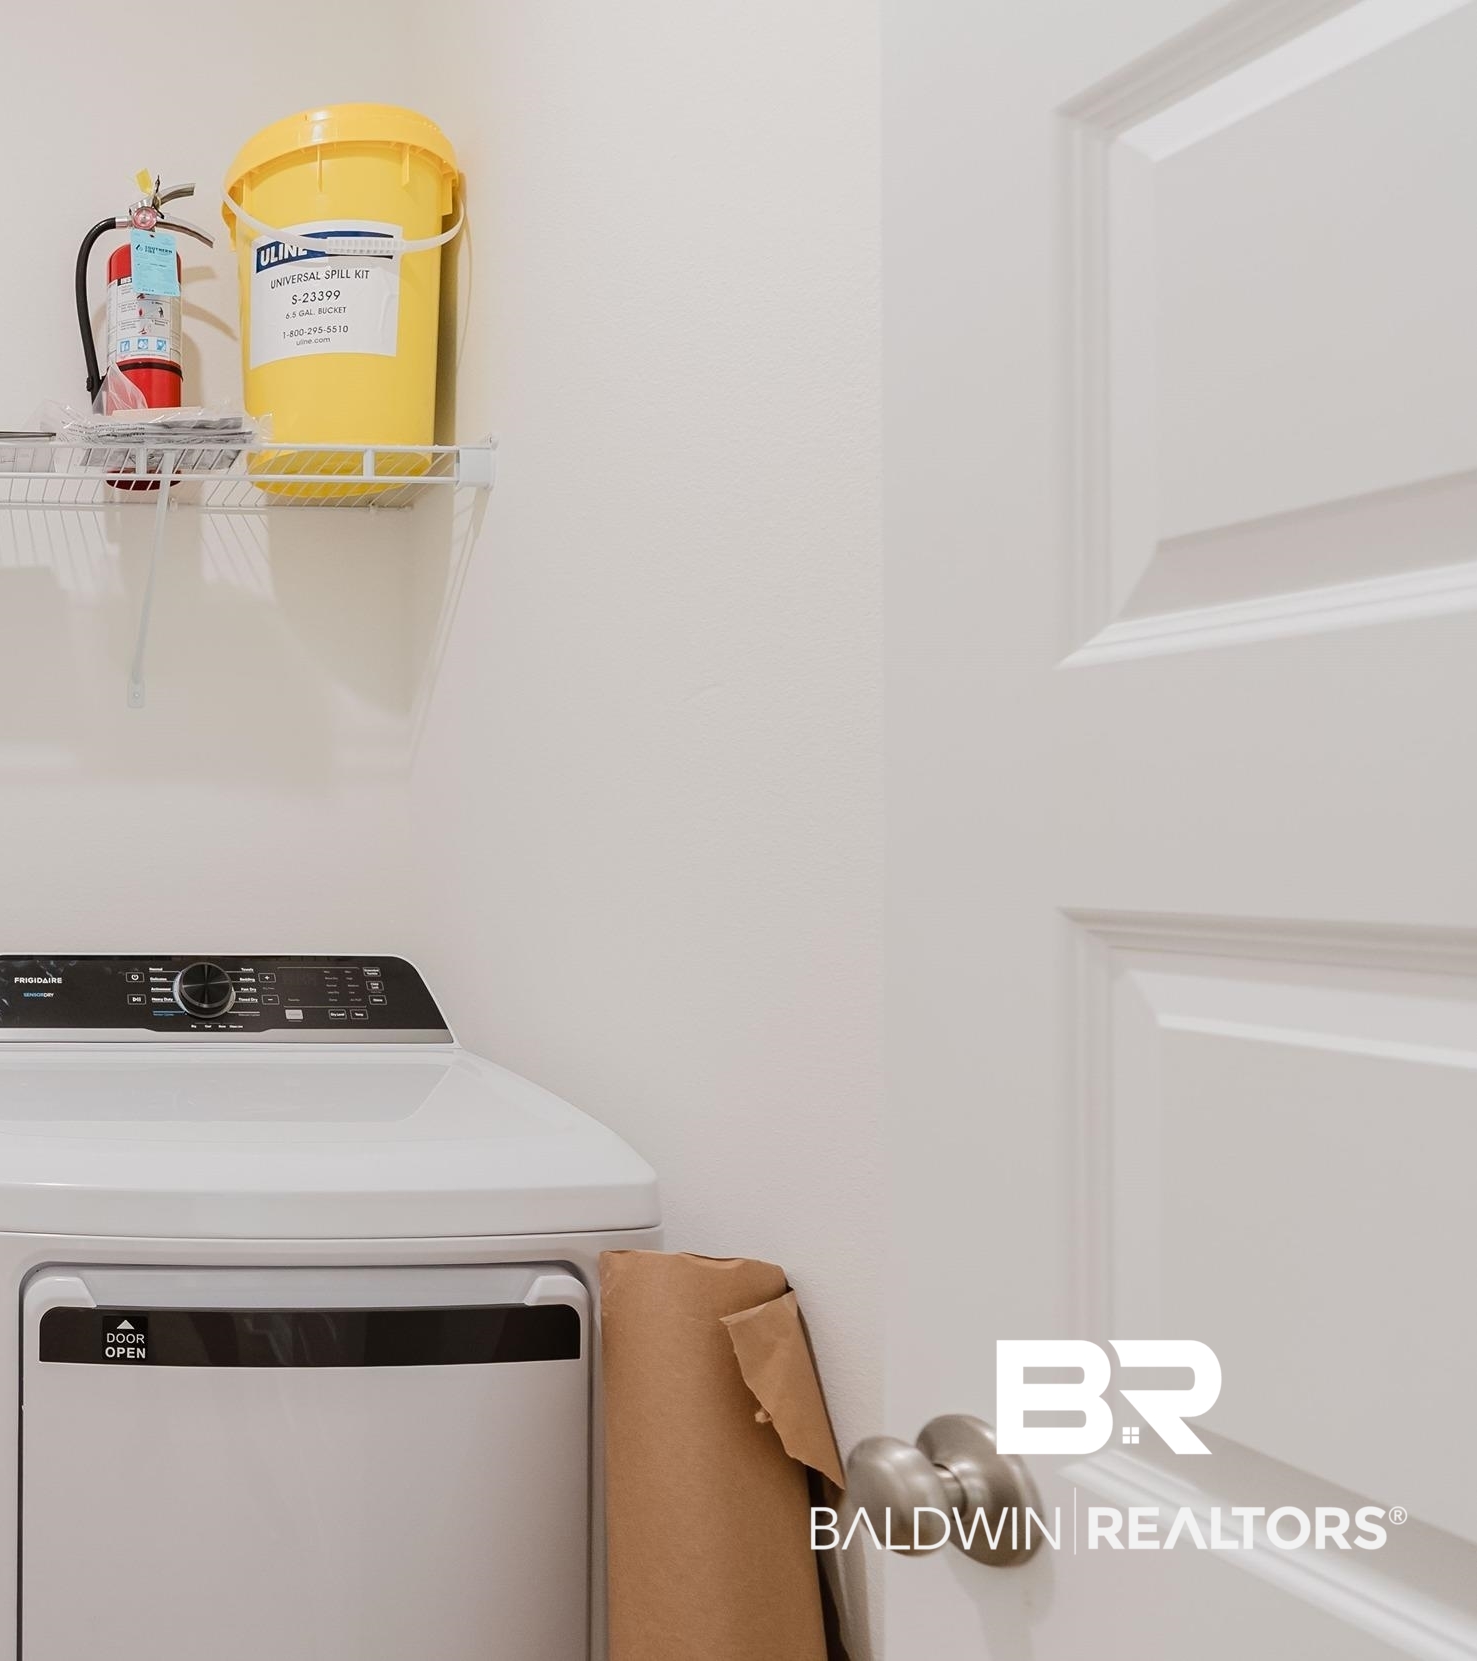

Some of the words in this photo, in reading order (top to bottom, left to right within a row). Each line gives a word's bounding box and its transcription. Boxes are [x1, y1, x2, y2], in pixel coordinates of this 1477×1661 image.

[270, 271, 321, 289] UNIVERSAL
[324, 269, 351, 280] SPILL
[354, 269, 370, 280] KIT
[291, 289, 341, 305] S-23399
[285, 311, 297, 320] 6.5
[298, 309, 315, 317] GAL.
[318, 306, 347, 315] BUCKET
[282, 325, 349, 339] 1-800-295-5510
[106, 1332, 145, 1344] DOOR
[105, 1346, 146, 1359] OPEN
